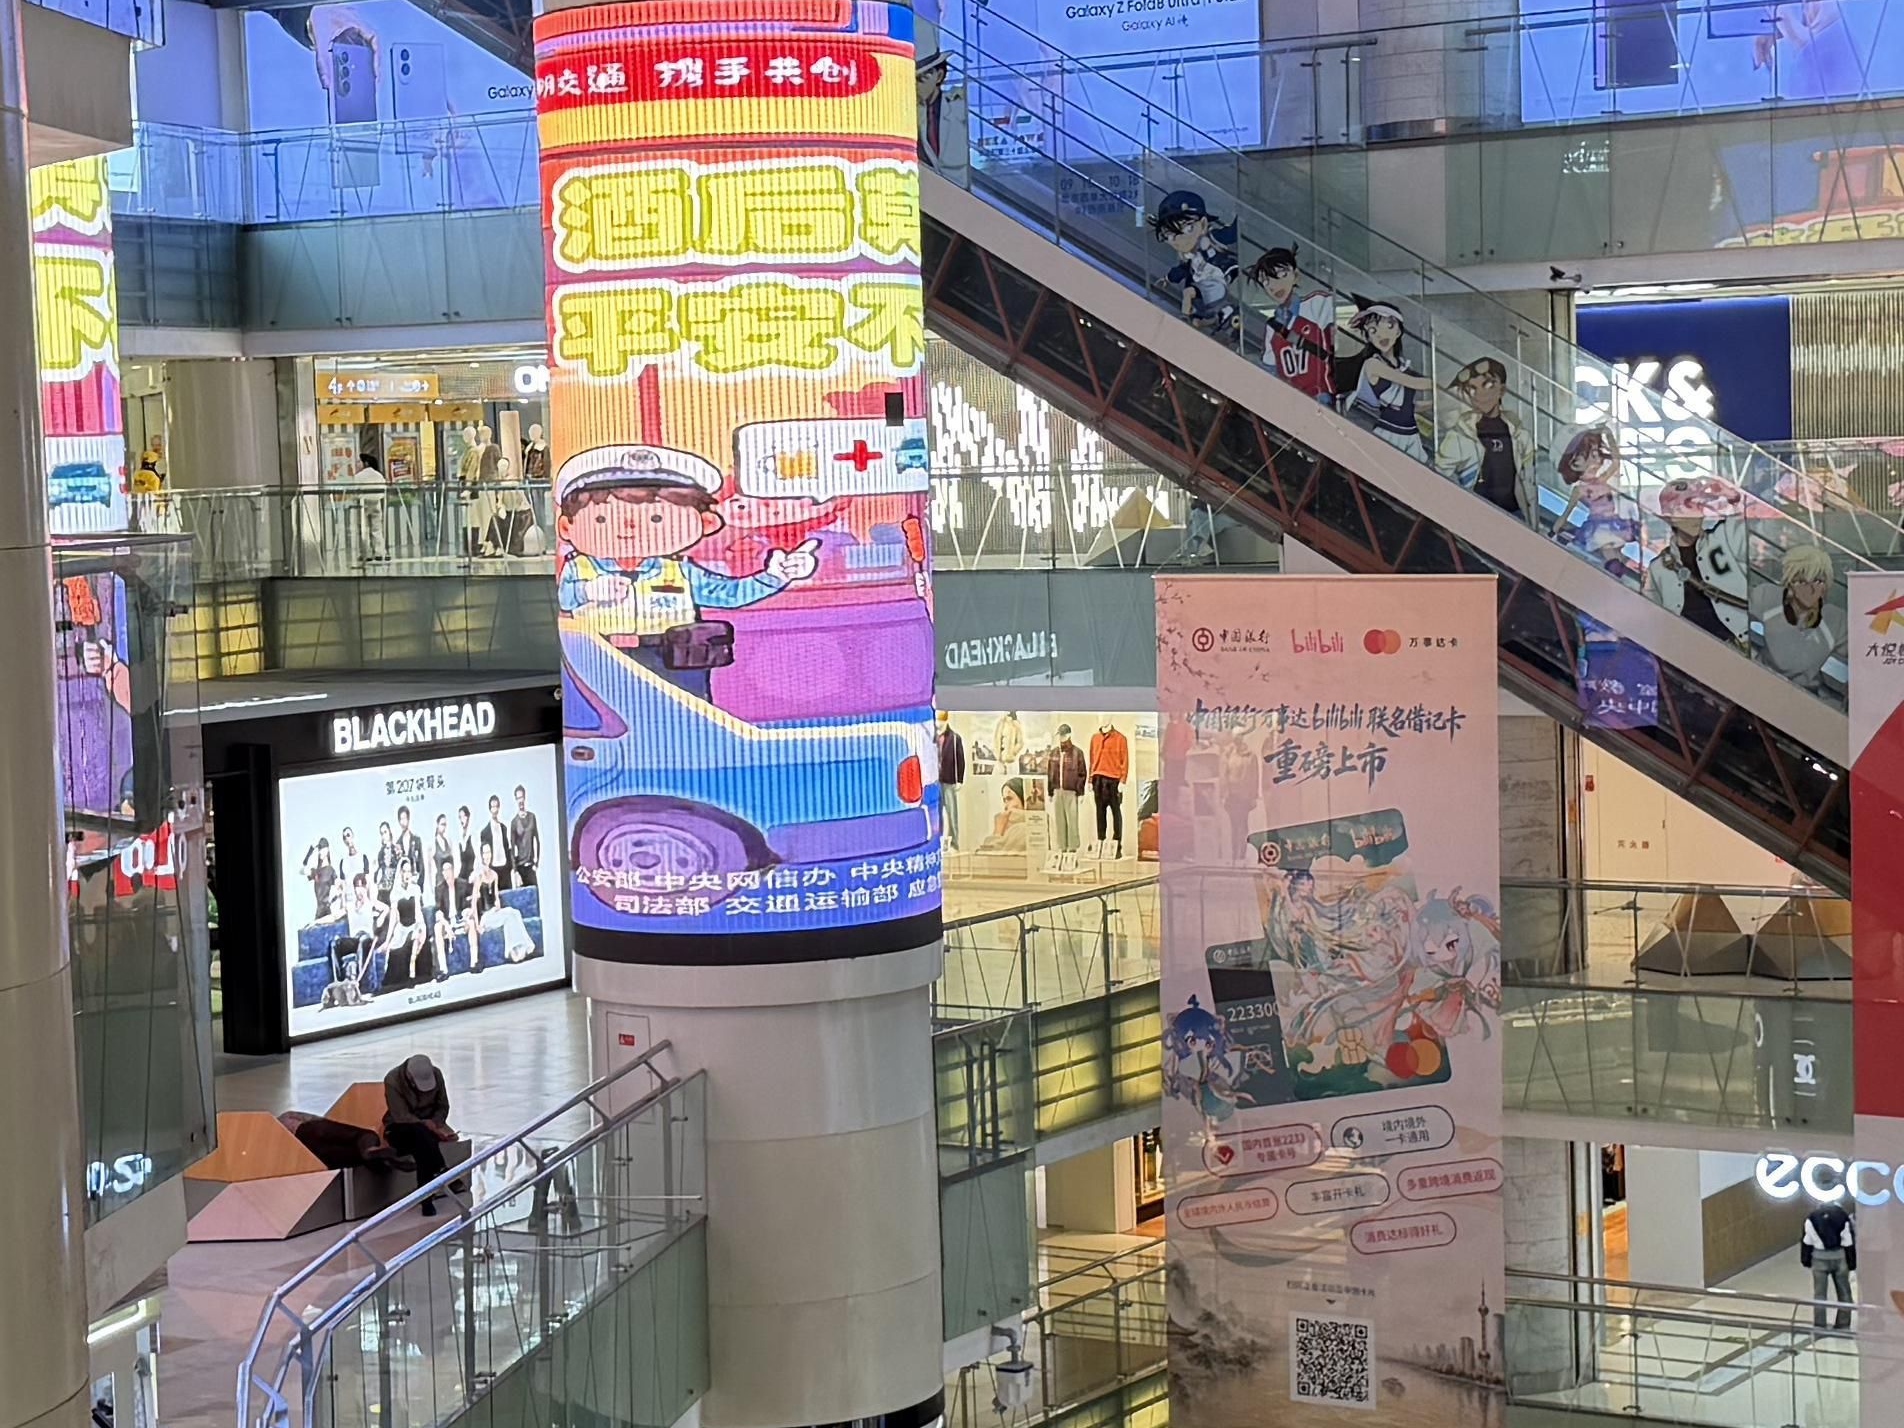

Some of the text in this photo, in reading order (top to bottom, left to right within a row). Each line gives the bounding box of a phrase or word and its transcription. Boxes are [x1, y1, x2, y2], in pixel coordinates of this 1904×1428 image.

[1065, 3, 1116, 19] Galaxy
[1117, 1, 1125, 14] Z
[1121, 18, 1163, 32] Galaxy
[654, 55, 858, 88] 携手共创
[486, 82, 534, 102] Galaxy
[1279, 344, 1309, 378] 07
[1708, 546, 1731, 576] C
[1291, 627, 1345, 654] bilibili
[1408, 636, 1459, 649] 万事达卡
[332, 700, 496, 754] BLACKHEAD
[1264, 738, 1389, 795] 重磅上市
[574, 866, 642, 890] 公安部
[654, 866, 836, 893] 中央网信办
[613, 894, 712, 917] 司法部
[725, 885, 900, 917] 交通运输部
